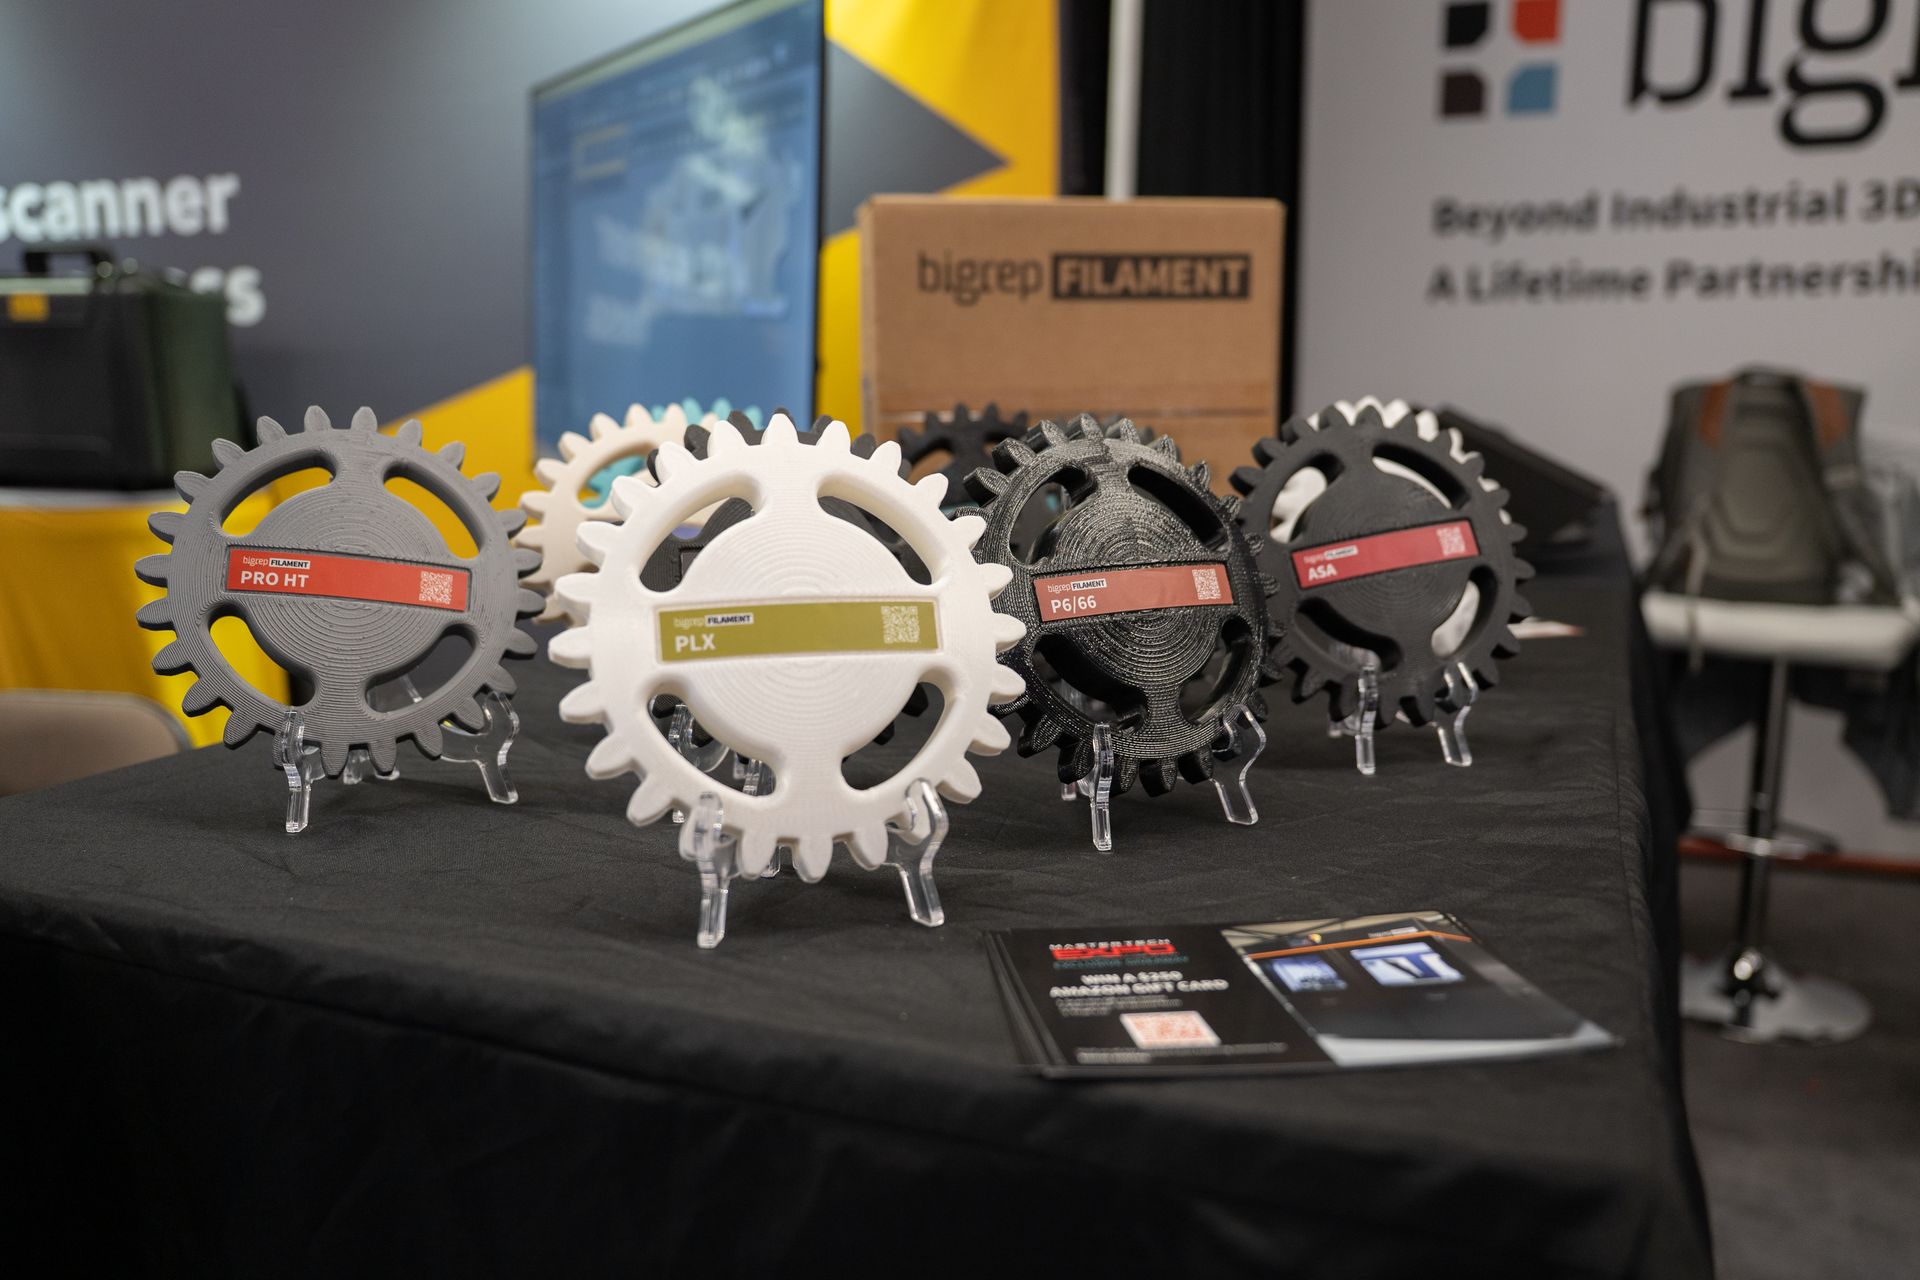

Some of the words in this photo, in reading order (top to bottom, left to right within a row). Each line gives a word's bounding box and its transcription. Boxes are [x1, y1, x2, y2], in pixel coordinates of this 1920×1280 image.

[1627, 0, 1920, 146] big
[0, 174, 240, 243] canner
[1432, 197, 1598, 242] Beyond
[1610, 182, 1846, 230] Industrial
[1860, 177, 1920, 222] 3D
[917, 252, 1044, 307] bigrep
[1056, 255, 1247, 297] FILAMENT
[1428, 265, 1456, 298] A
[1466, 259, 1651, 302] Lifetime
[242, 556, 269, 566] bigrep
[269, 559, 310, 569] FILAMENT
[241, 570, 279, 586] PRO
[284, 573, 309, 588] HT
[1308, 564, 1337, 581] ASA
[1047, 583, 1071, 594] bigrep
[1071, 579, 1106, 591] FILAMENT
[1051, 595, 1097, 613] P6/66
[706, 614, 752, 626] FILAMENT
[675, 634, 716, 652] PLX
[1049, 984, 1131, 998] AMAZON
[1131, 981, 1175, 994] GIFT
[1176, 978, 1229, 992] CARD
